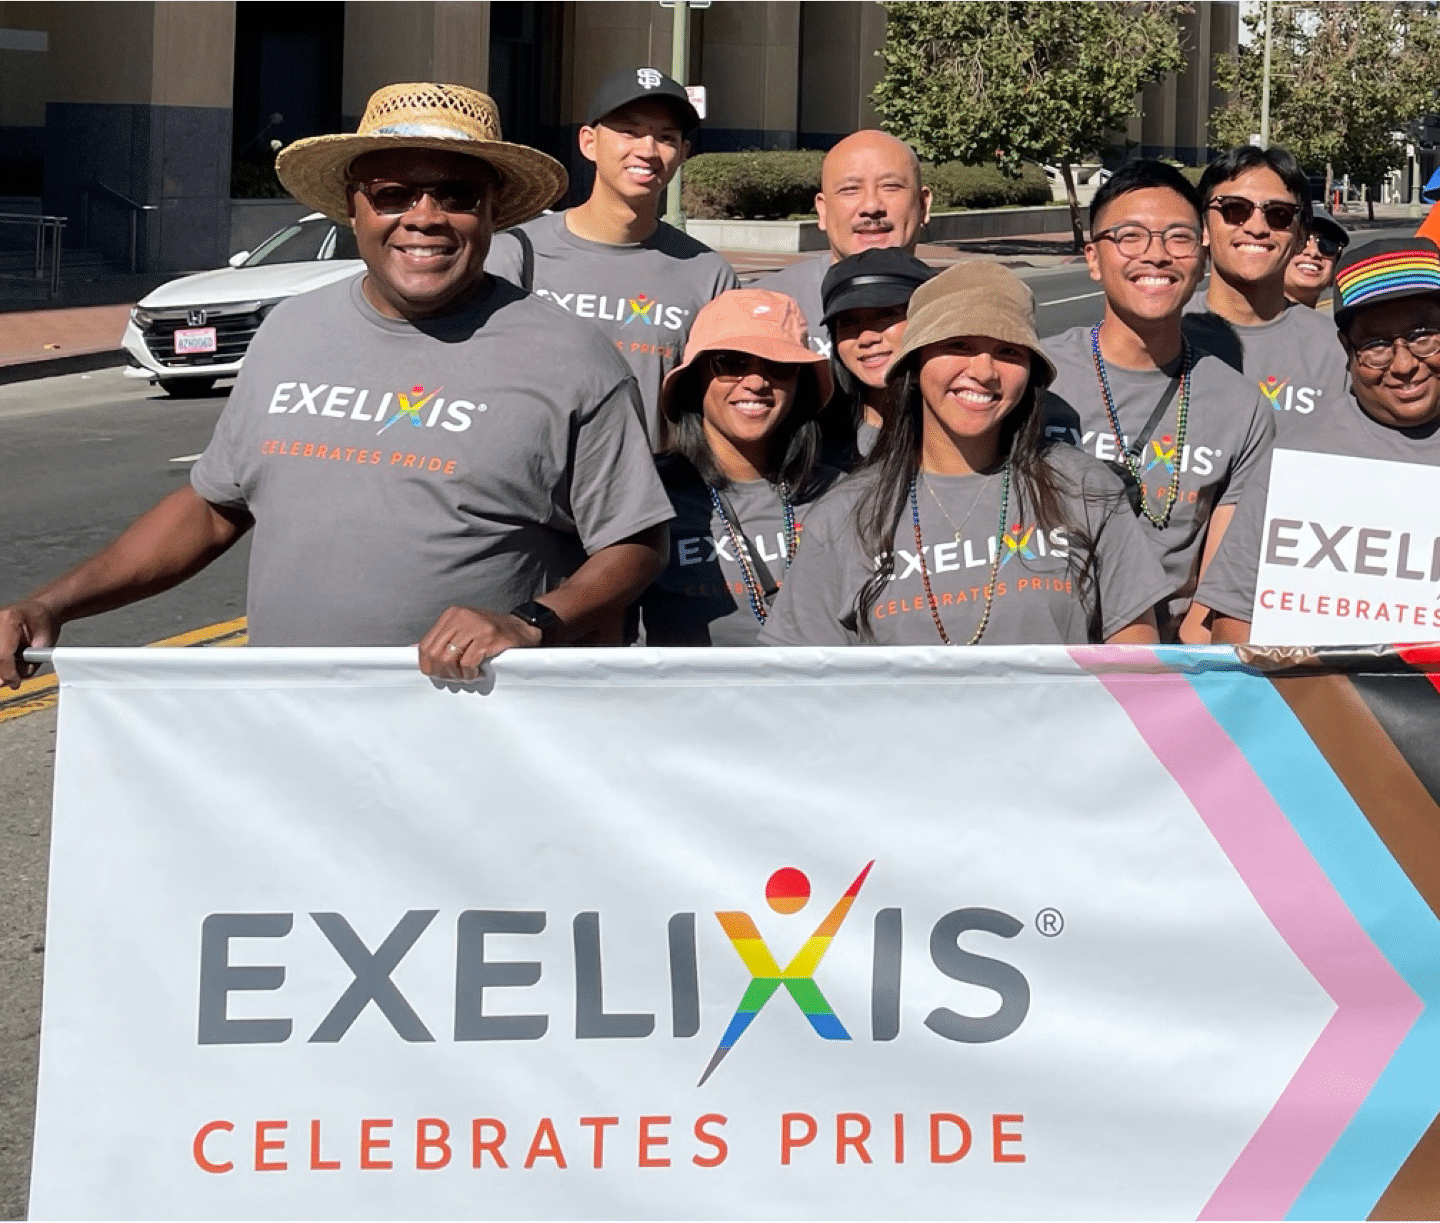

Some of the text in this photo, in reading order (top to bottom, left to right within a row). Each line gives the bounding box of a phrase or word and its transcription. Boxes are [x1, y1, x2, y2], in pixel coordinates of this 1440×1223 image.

[260, 440, 458, 475] CELEBRATES PRIDE
[192, 1112, 1029, 1174] CELEBRATES PRIDE
